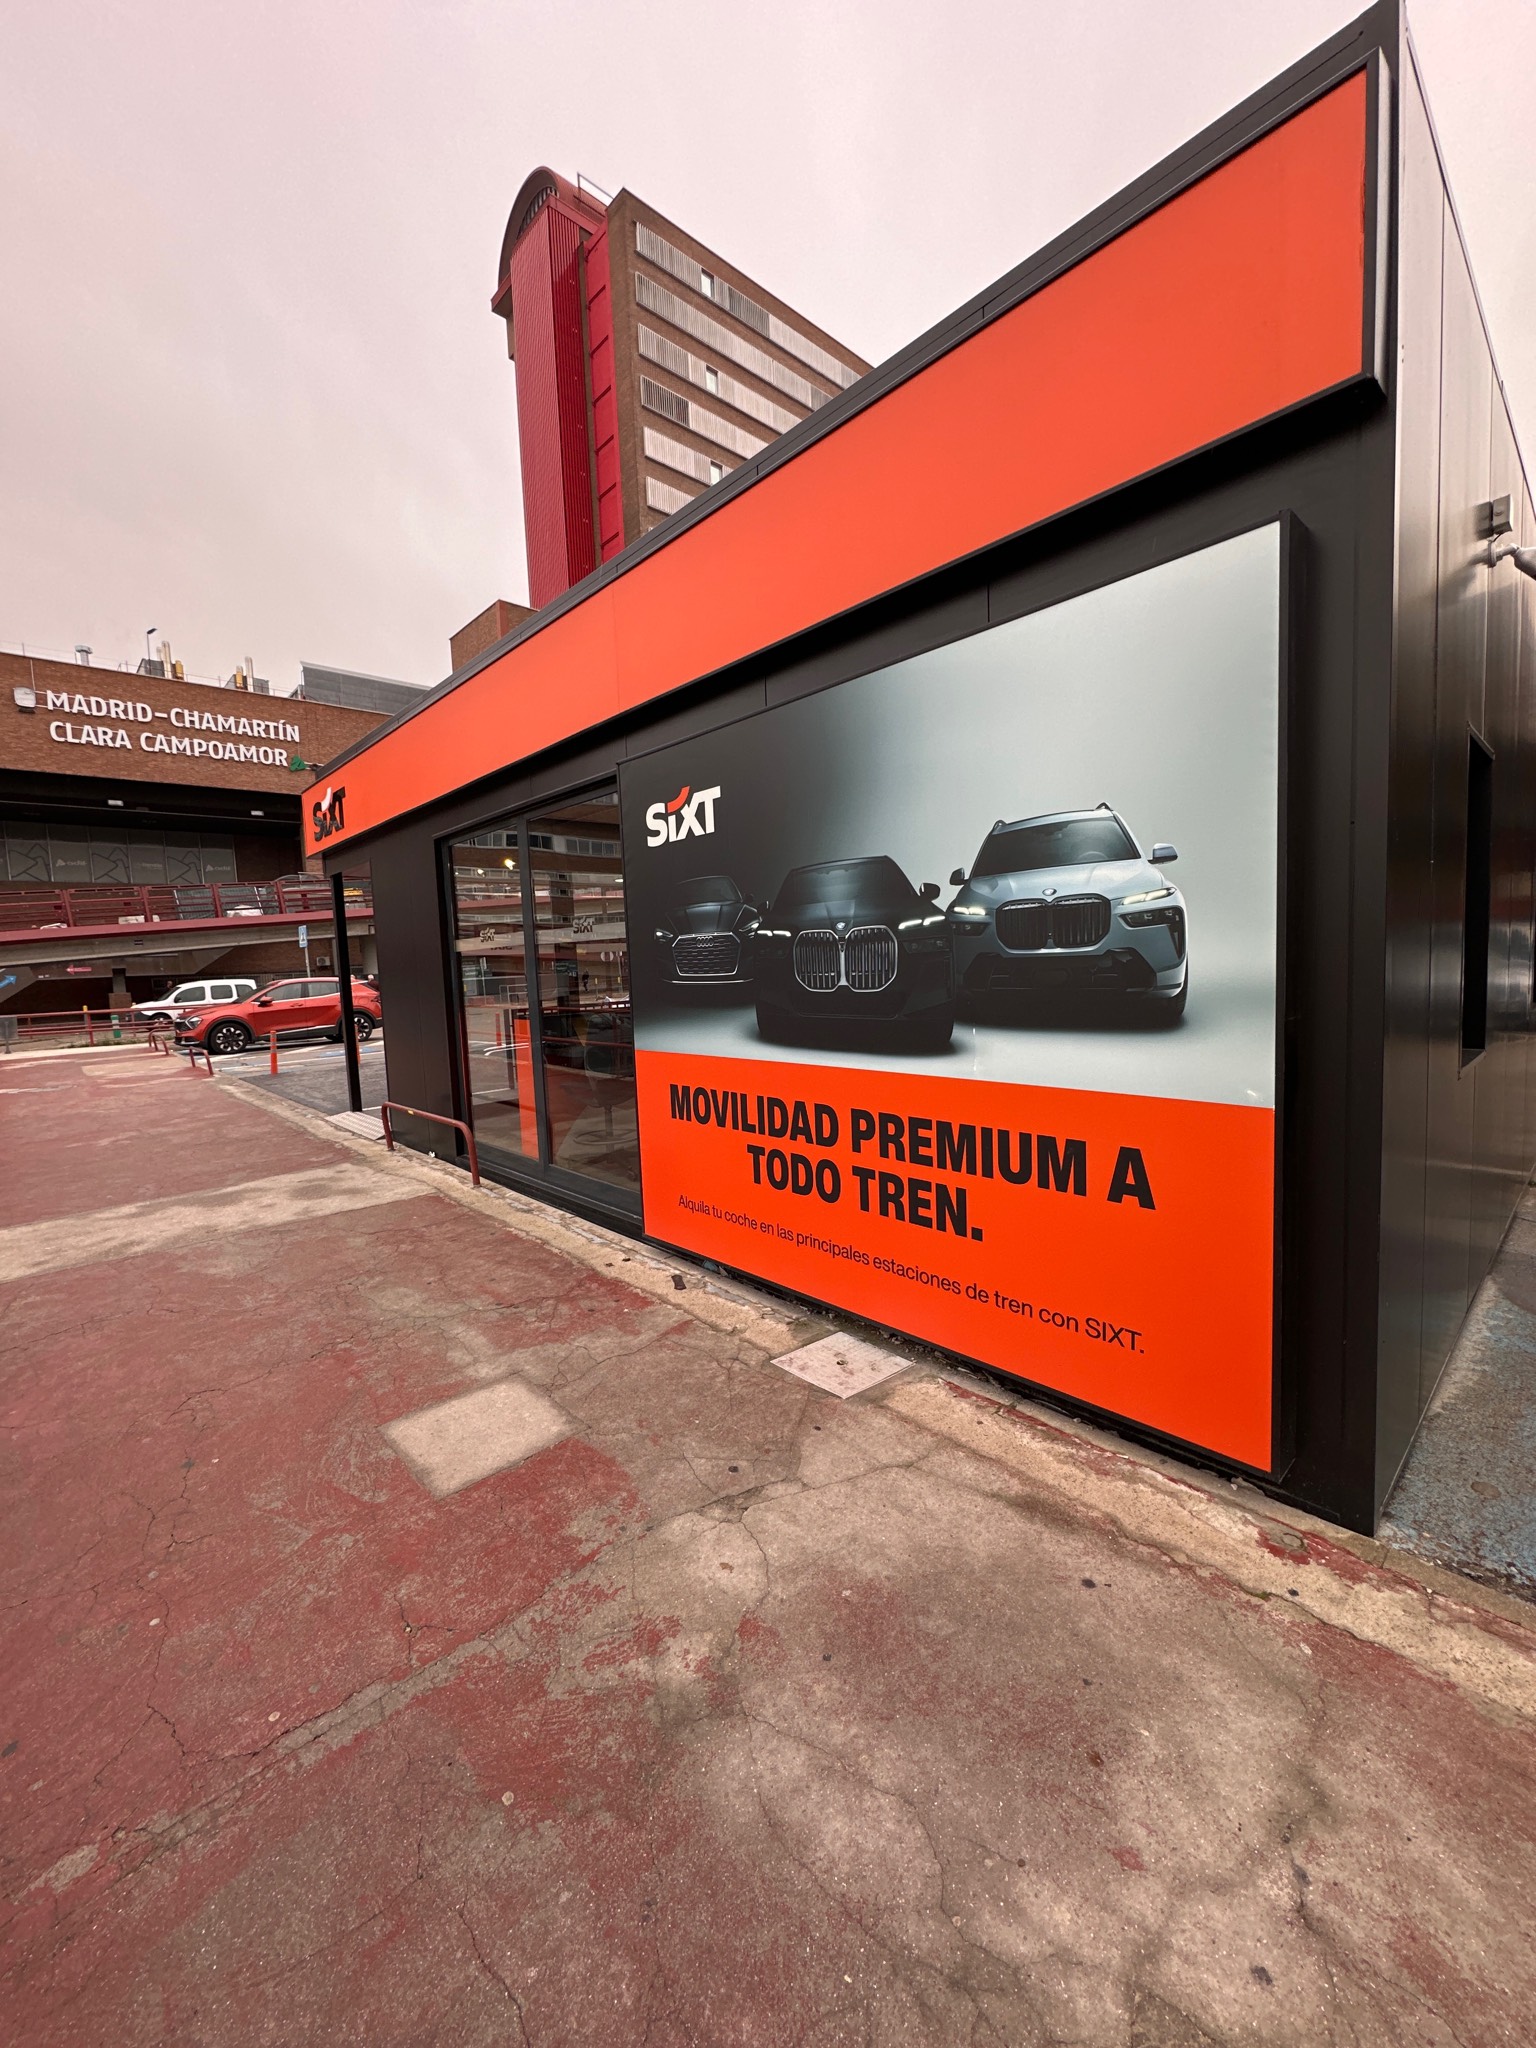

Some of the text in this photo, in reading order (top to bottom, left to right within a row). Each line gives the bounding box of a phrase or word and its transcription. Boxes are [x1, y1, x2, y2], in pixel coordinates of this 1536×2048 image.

[49, 721, 289, 767] CLARA CAMPOAMOR
[669, 1083, 1157, 1211] MOVILIDAD PREMIUM A
[746, 1143, 983, 1242] TODO TREN.
[678, 1194, 1145, 1354] Alquila tu coche en las principales estaciones de tren con SIXT.
